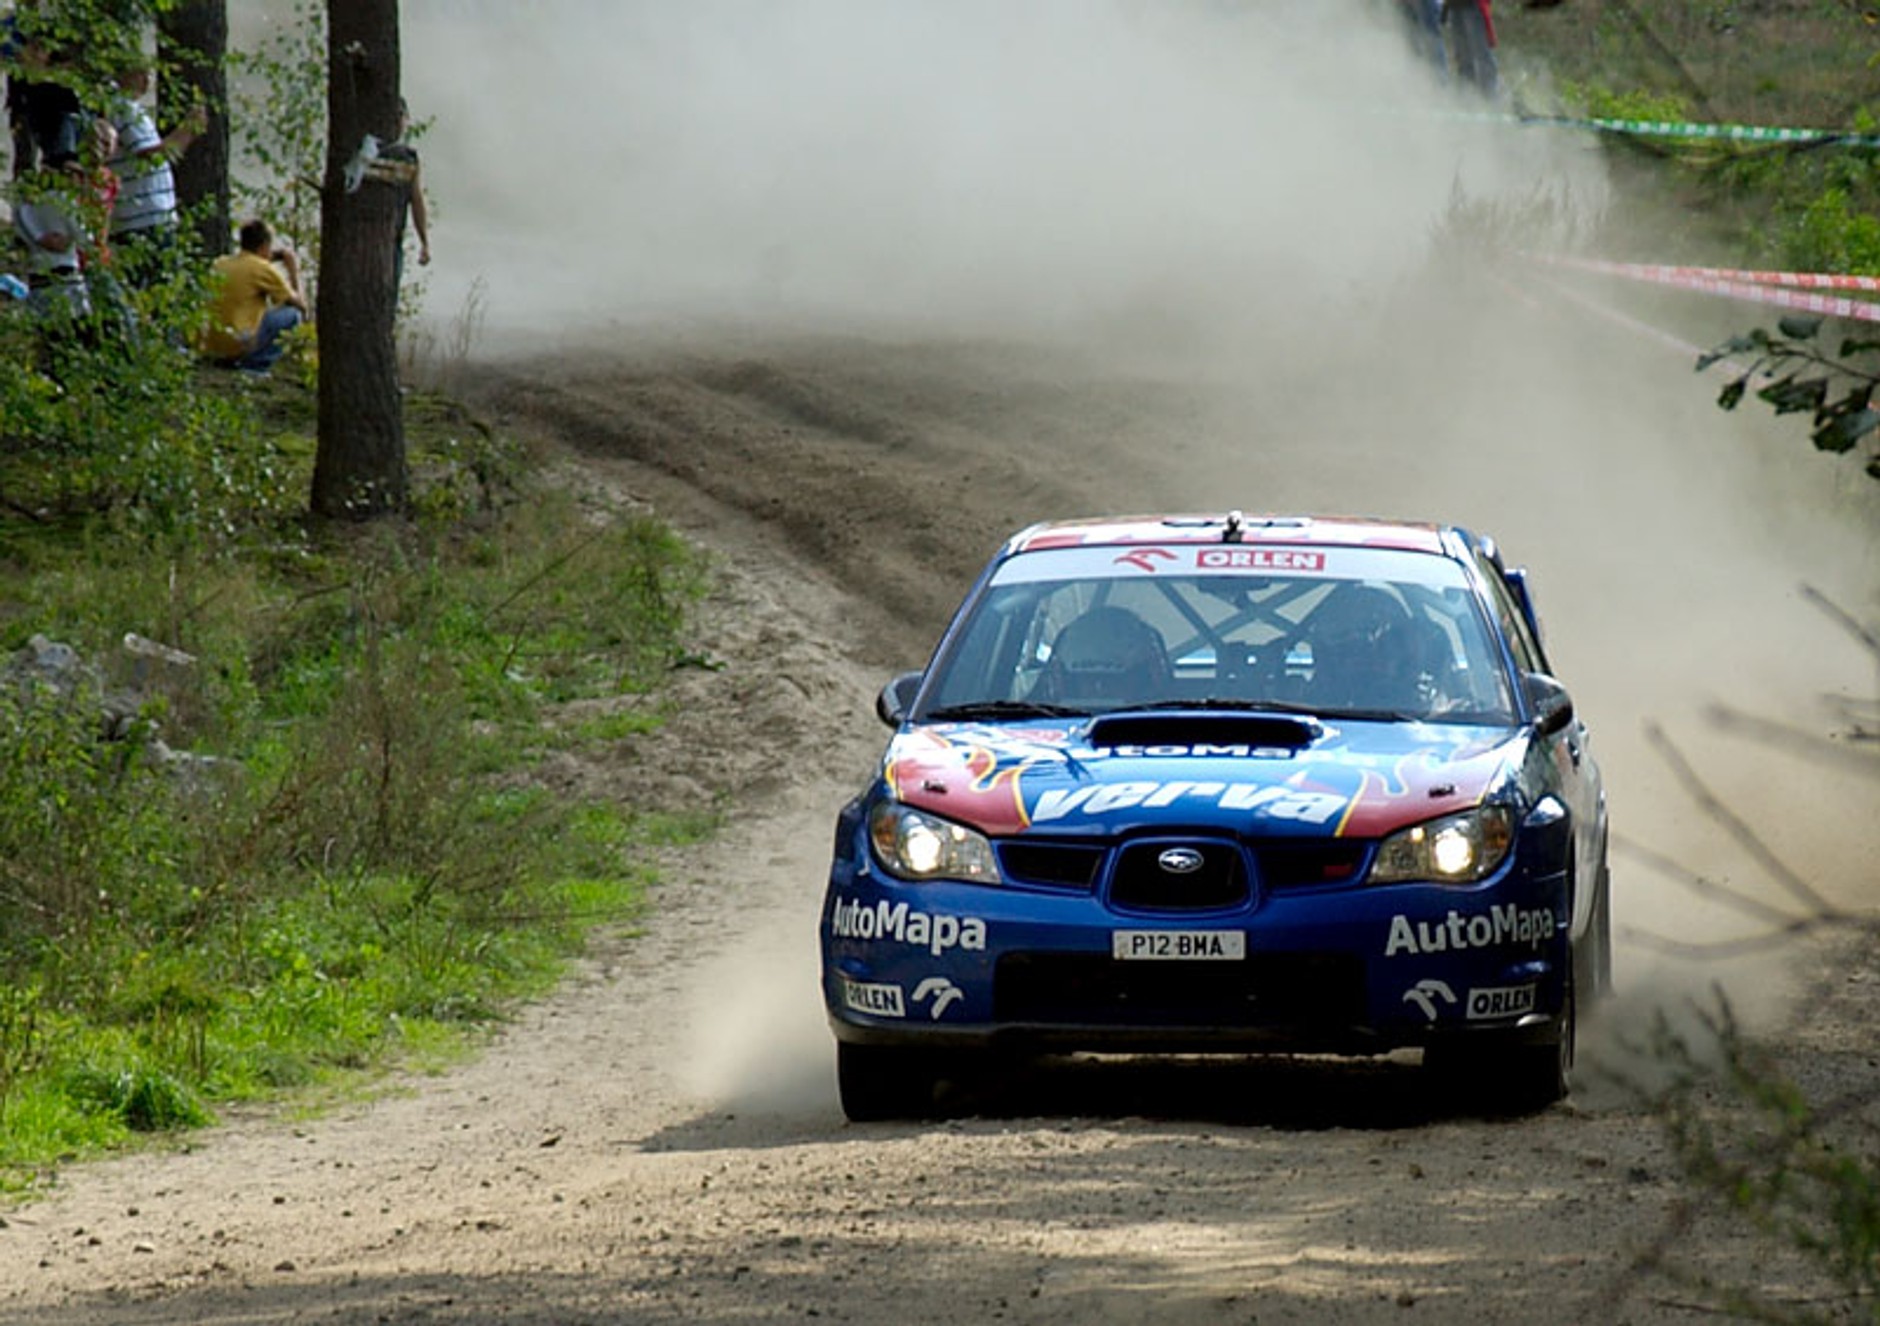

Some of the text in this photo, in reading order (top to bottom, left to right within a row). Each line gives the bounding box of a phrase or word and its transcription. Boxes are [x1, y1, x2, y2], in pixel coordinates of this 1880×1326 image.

[1202, 551, 1318, 570] ORLEN
[1032, 781, 1348, 824] verva
[833, 896, 987, 956] AutoMapa
[1385, 903, 1554, 956] AutoMapa
[1132, 935, 1224, 956] P12 BMA
[848, 983, 899, 1012] ORLEN
[1473, 988, 1532, 1015] ORLEN
